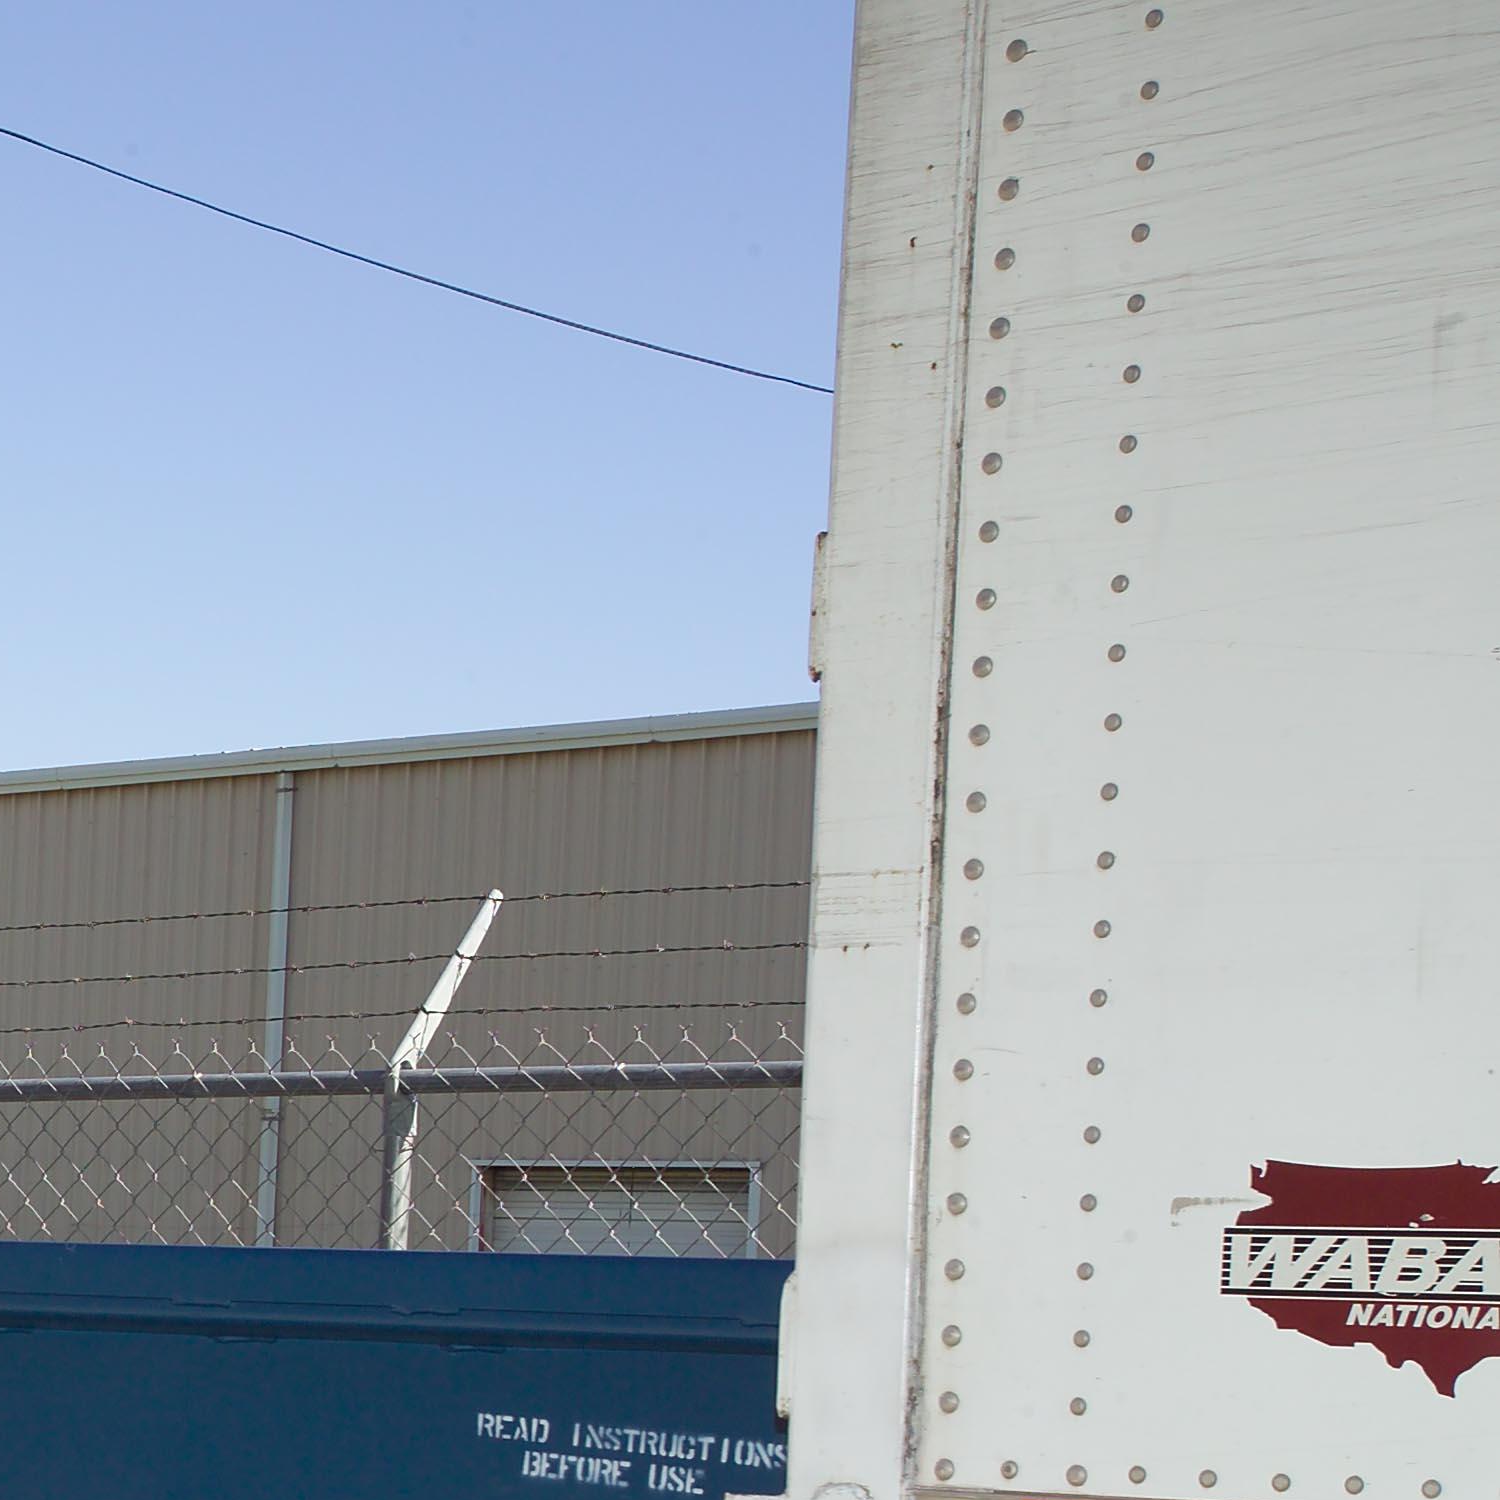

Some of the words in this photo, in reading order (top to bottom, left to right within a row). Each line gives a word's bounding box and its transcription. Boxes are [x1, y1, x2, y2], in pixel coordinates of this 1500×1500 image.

[1346, 1304, 1500, 1330] NATIONA
[477, 1412, 550, 1443] READ
[573, 1422, 788, 1469] INSTRUCTIONS
[522, 1450, 632, 1488] BEFORE
[648, 1464, 704, 1495] USE
